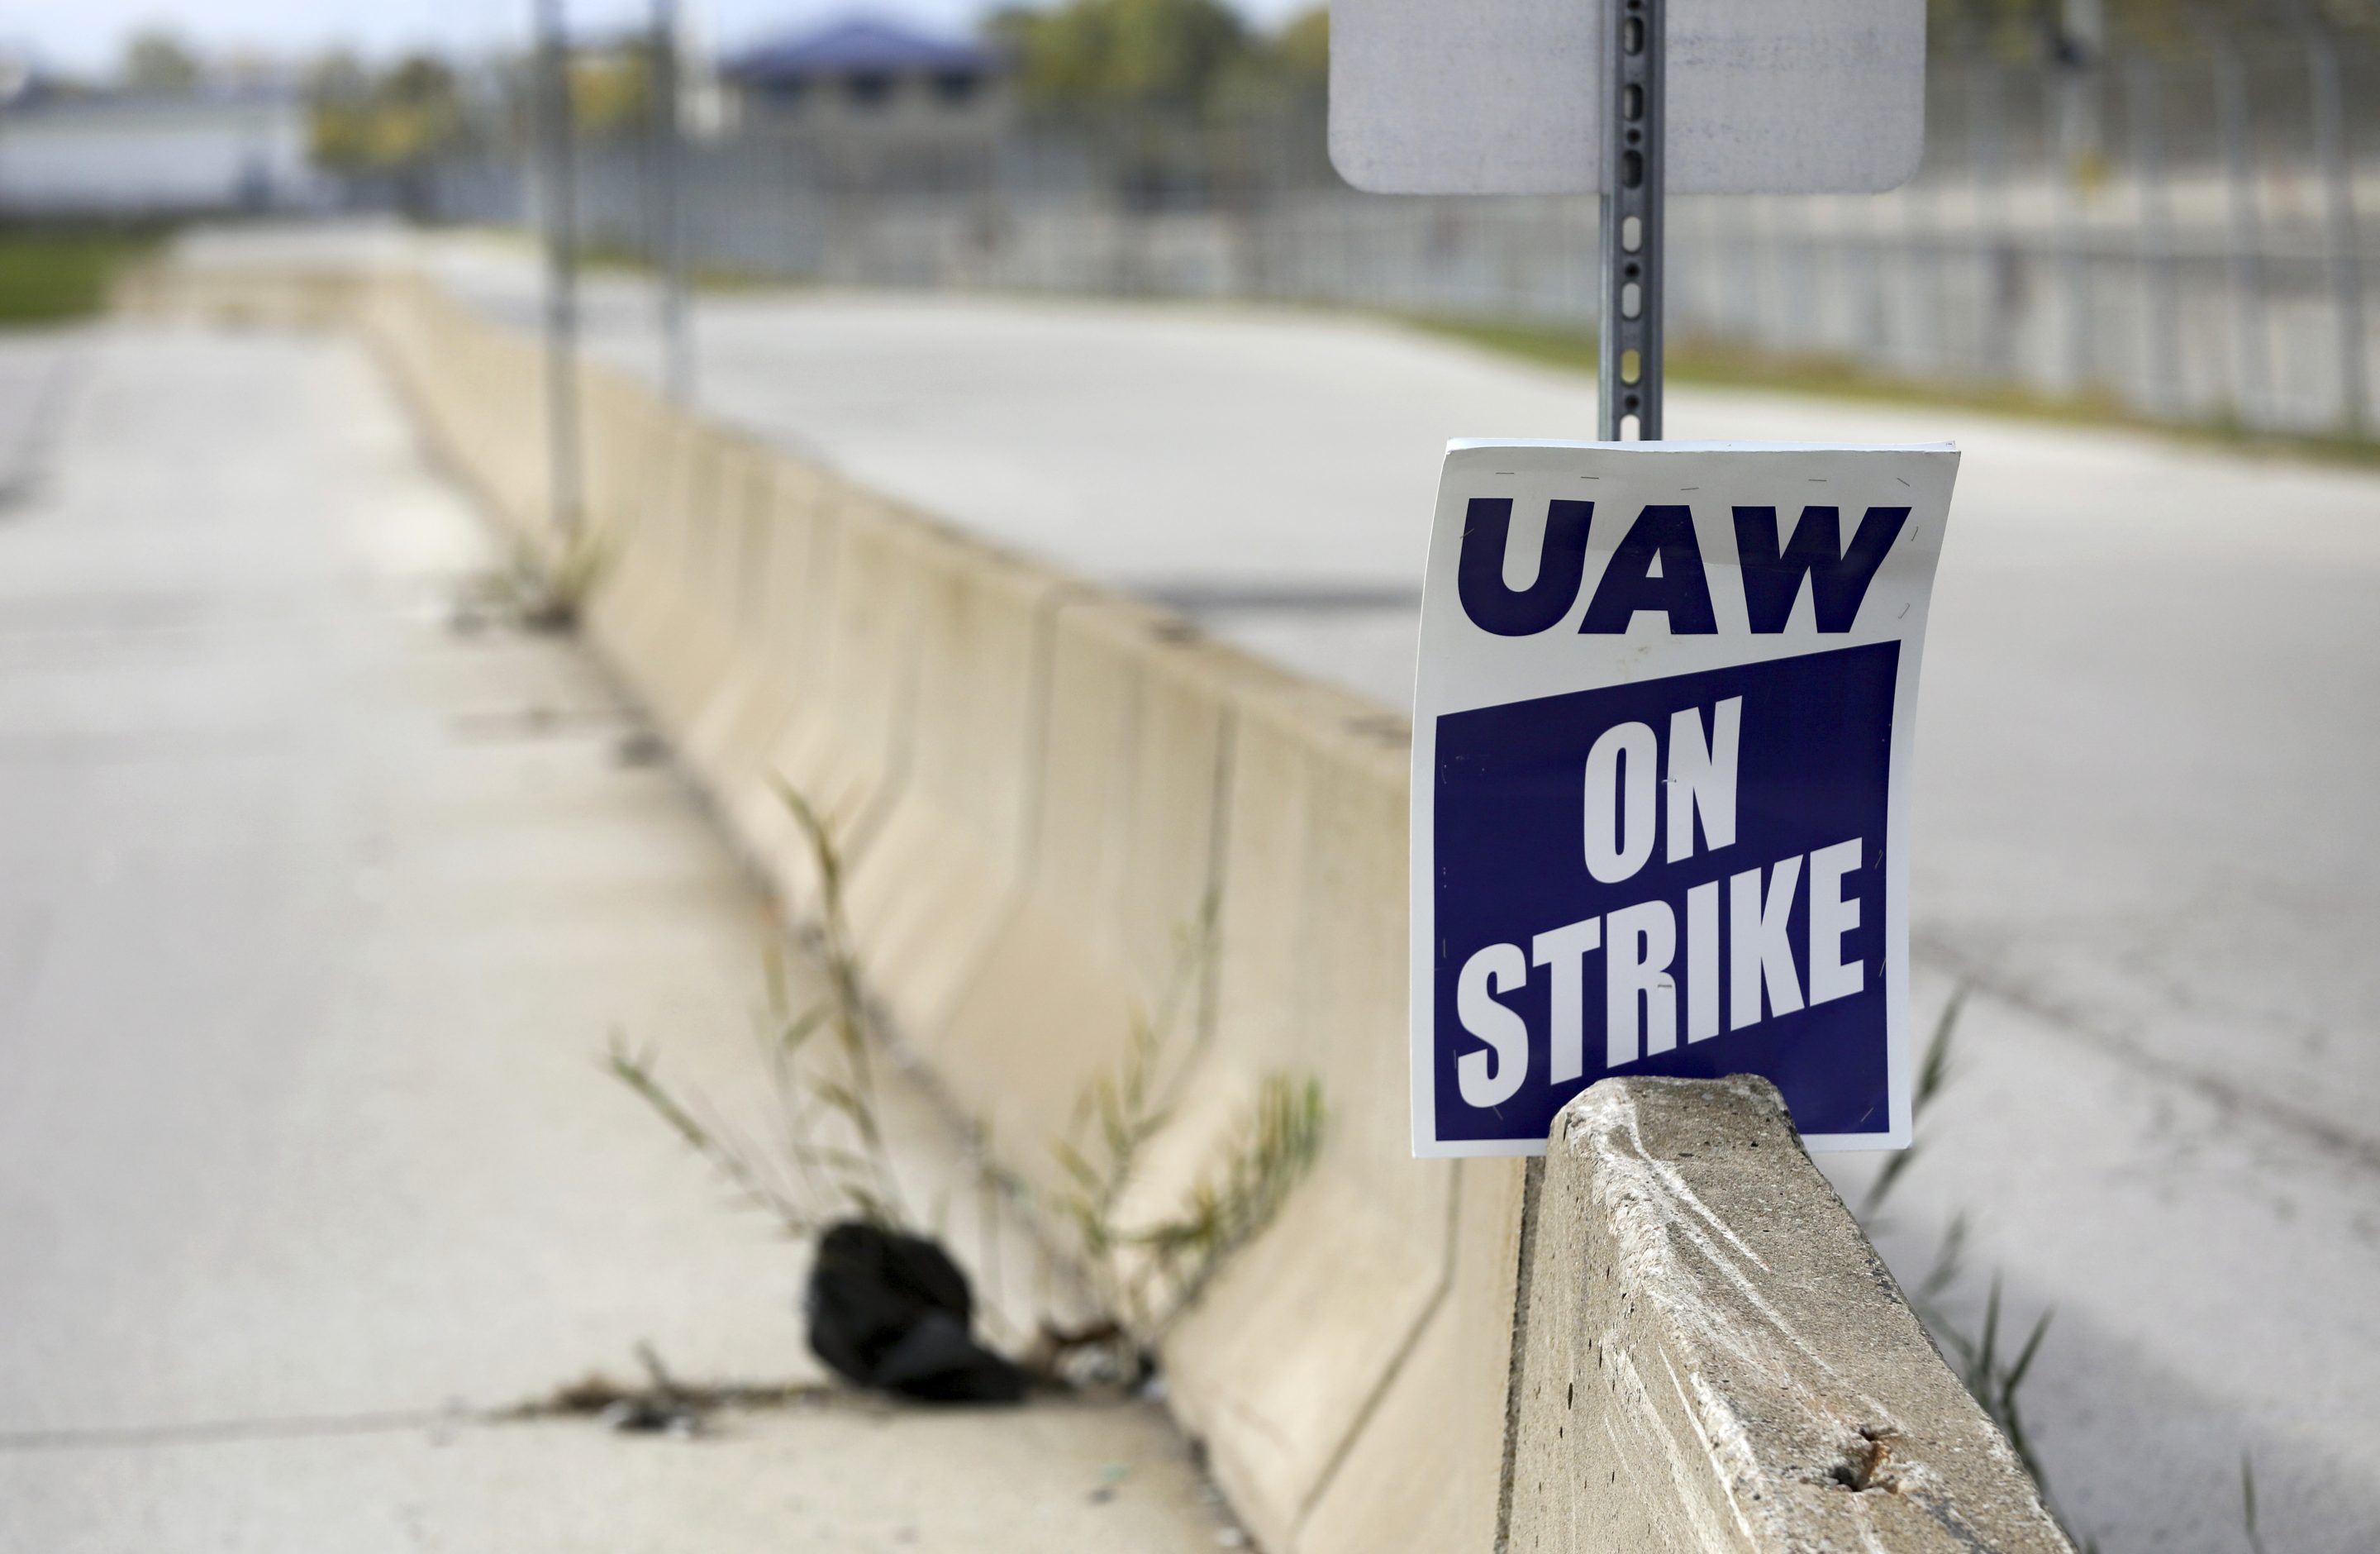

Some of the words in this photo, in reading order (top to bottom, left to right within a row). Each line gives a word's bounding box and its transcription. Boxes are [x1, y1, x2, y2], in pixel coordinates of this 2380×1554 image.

[1458, 498, 1912, 636] UAW
[1583, 695, 1743, 884] ON
[1457, 837, 1864, 1108] STRIKE
